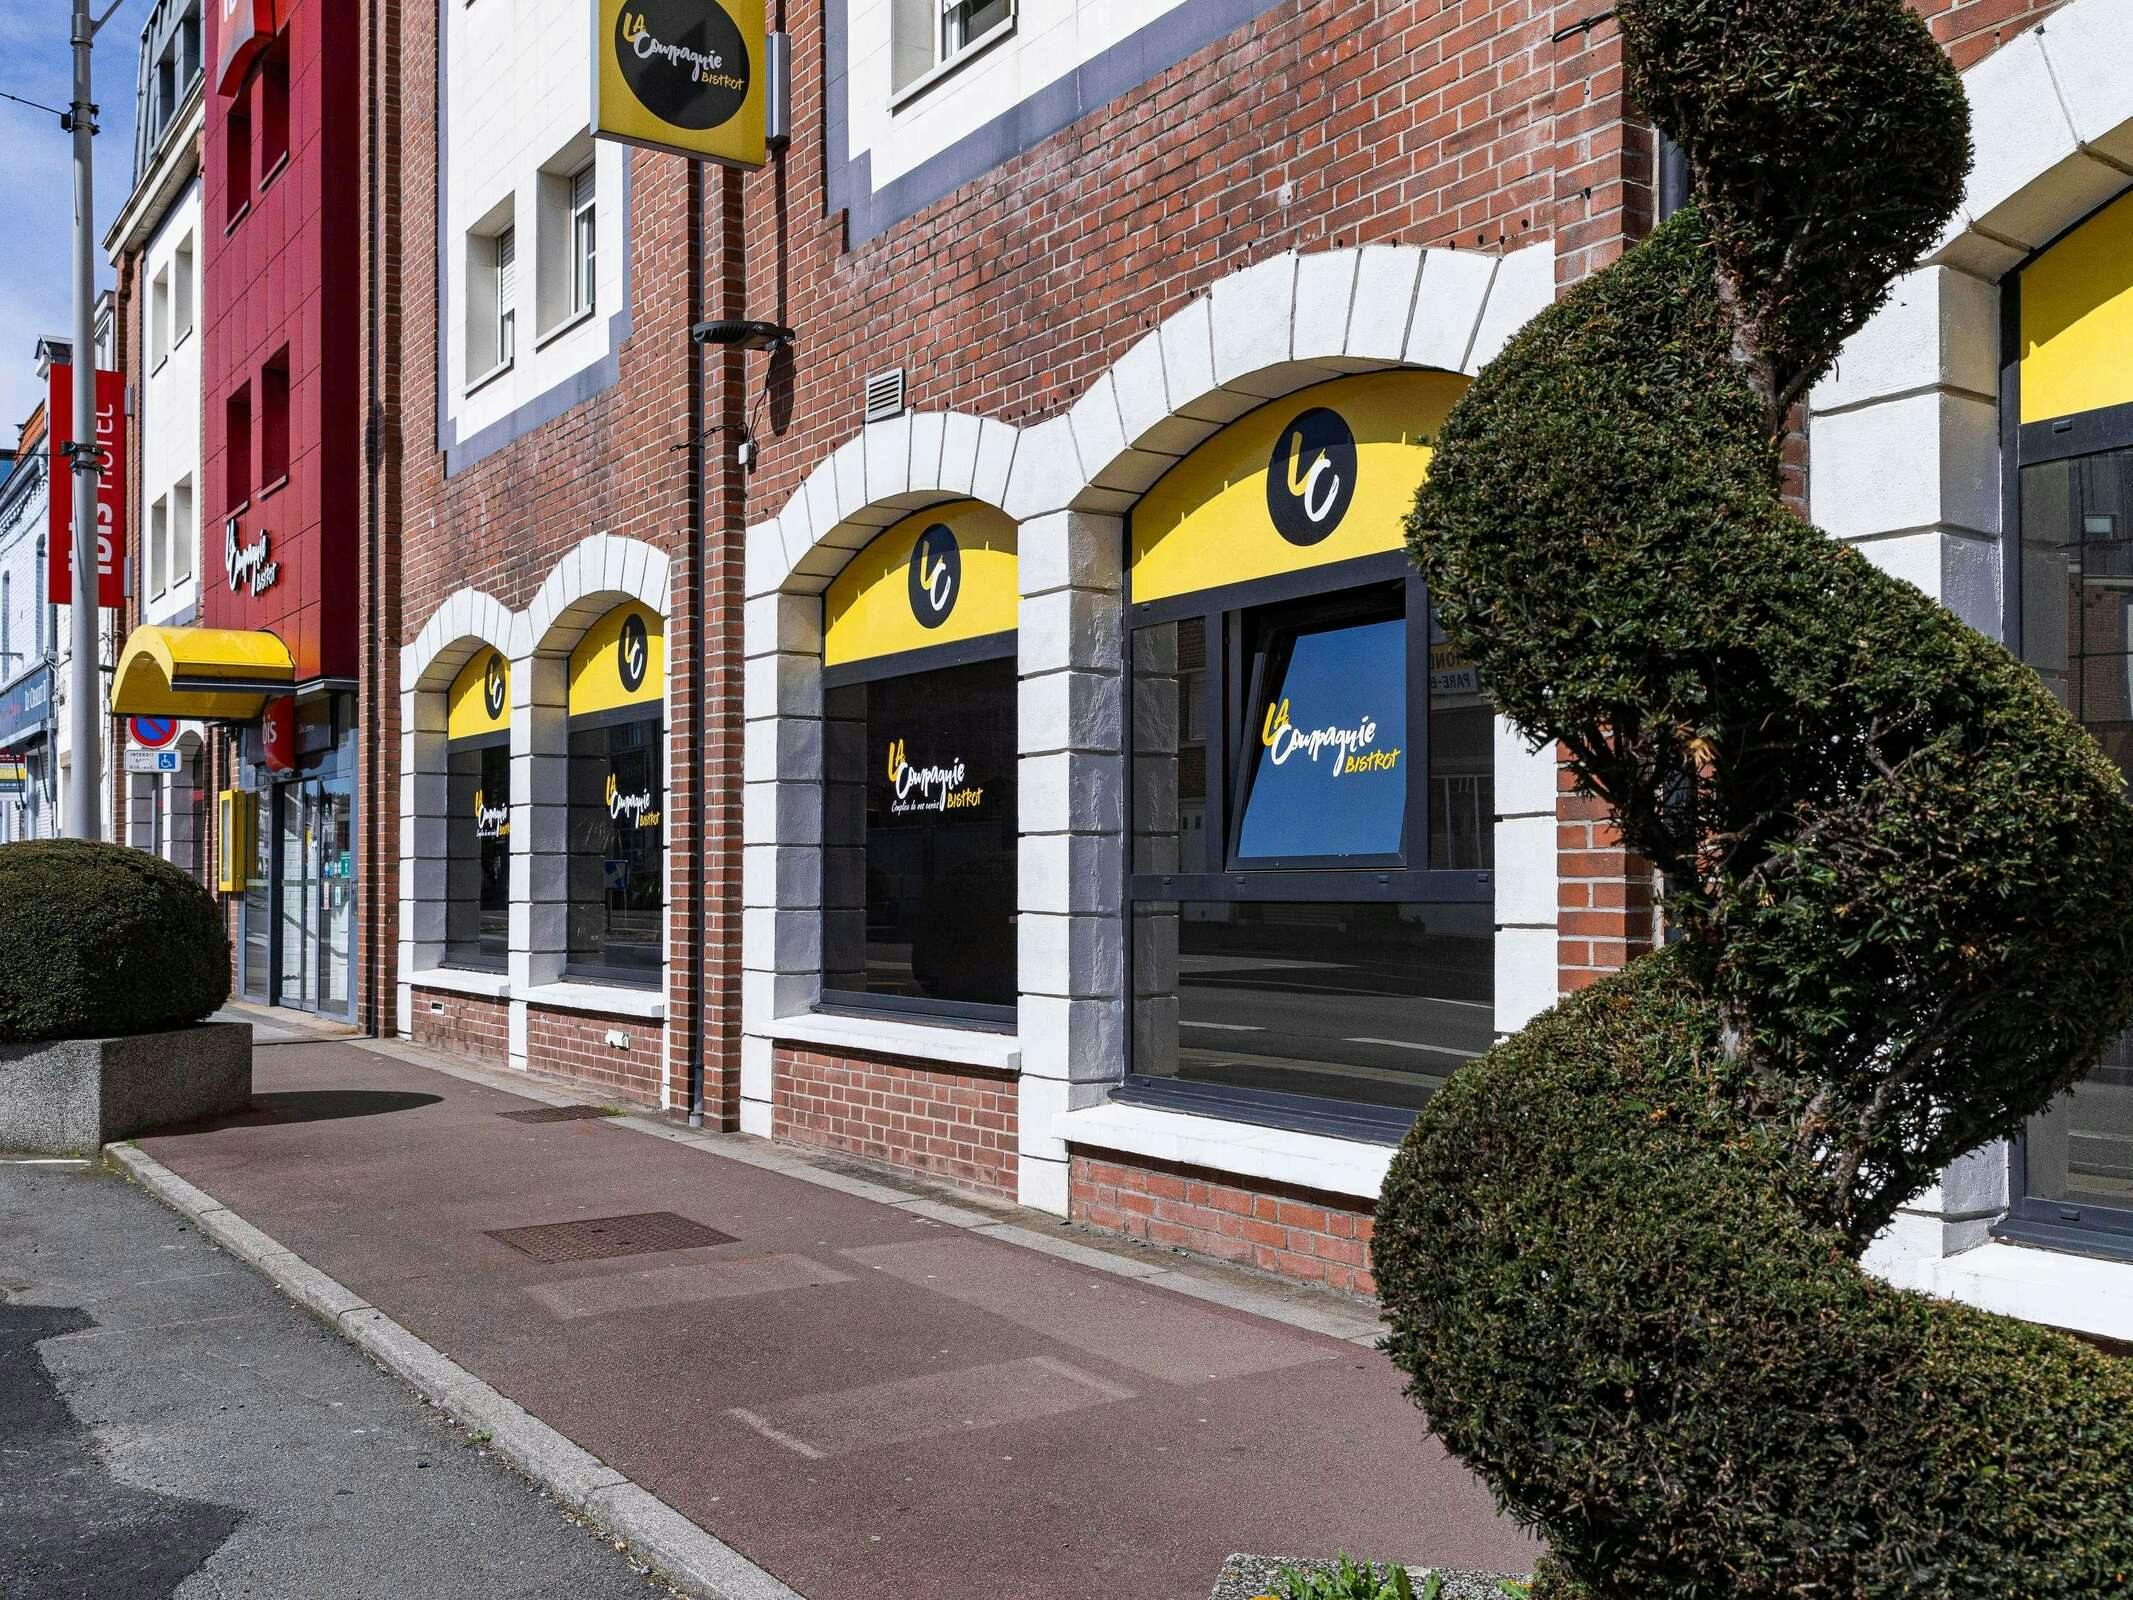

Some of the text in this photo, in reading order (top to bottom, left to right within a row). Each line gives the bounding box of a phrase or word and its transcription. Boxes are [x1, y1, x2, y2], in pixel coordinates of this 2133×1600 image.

[623, 12, 648, 43] LA
[633, 31, 722, 82] Compagnie
[1262, 698, 1290, 746] LA
[888, 739, 905, 782] LA
[1271, 716, 1376, 777] Compagnie
[610, 788, 651, 829] Compagnie
[895, 757, 965, 812] Compagnie
